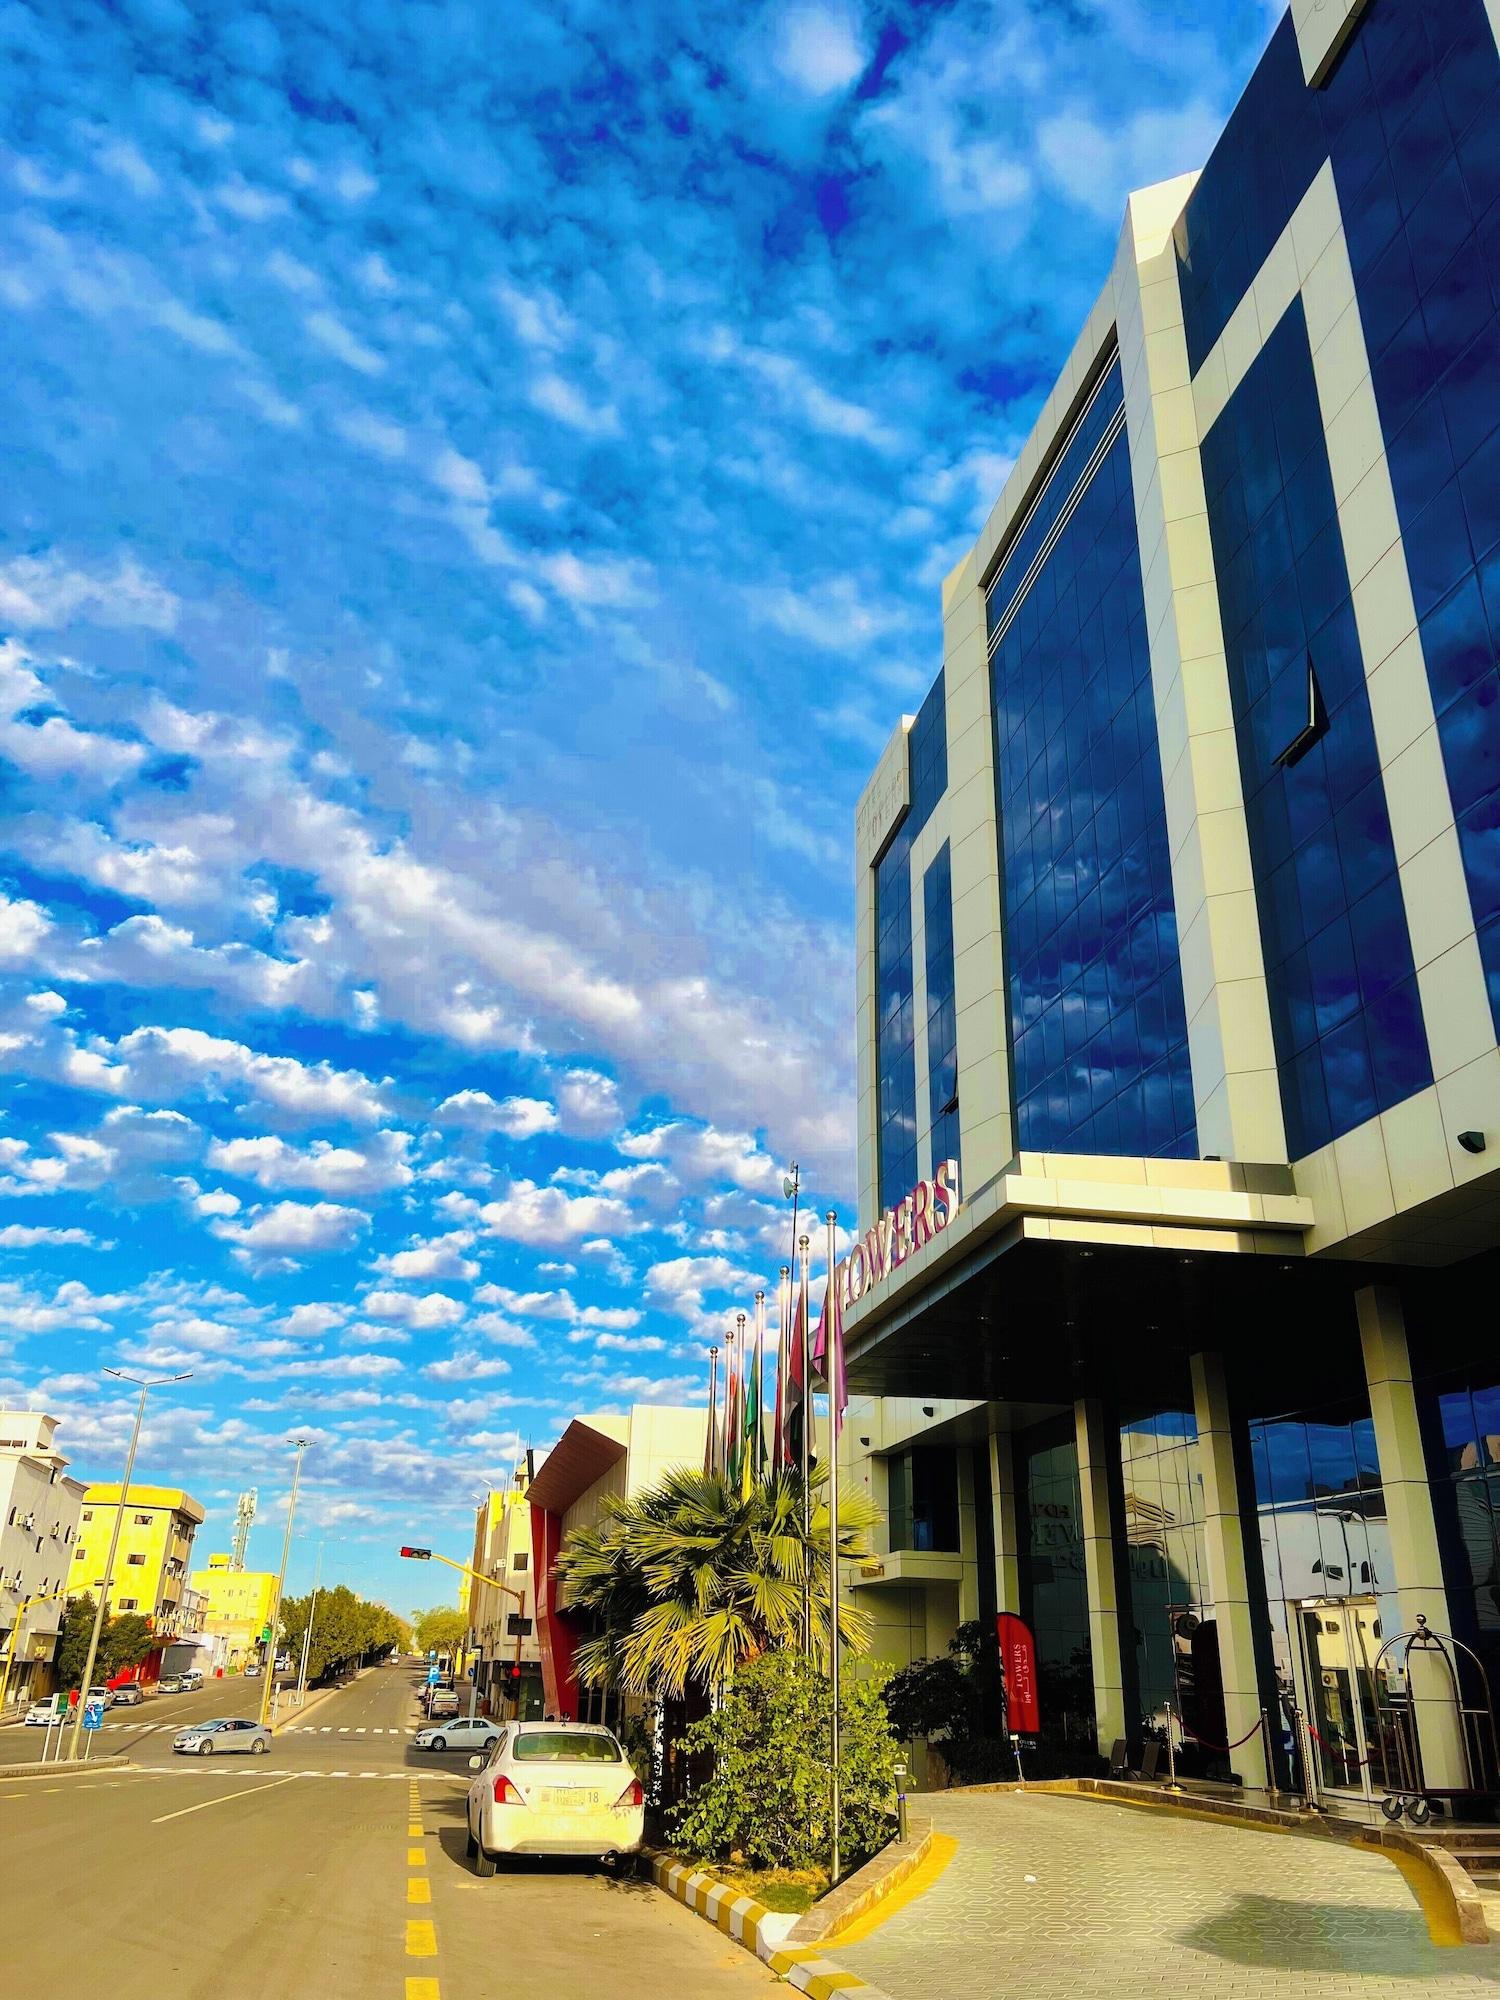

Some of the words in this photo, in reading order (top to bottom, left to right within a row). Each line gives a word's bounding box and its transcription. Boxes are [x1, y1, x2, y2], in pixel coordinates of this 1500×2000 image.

[834, 1157, 959, 1311] TOWERS
[429, 1667, 440, 1679] P
[1013, 1643, 1023, 1688] TOWERS
